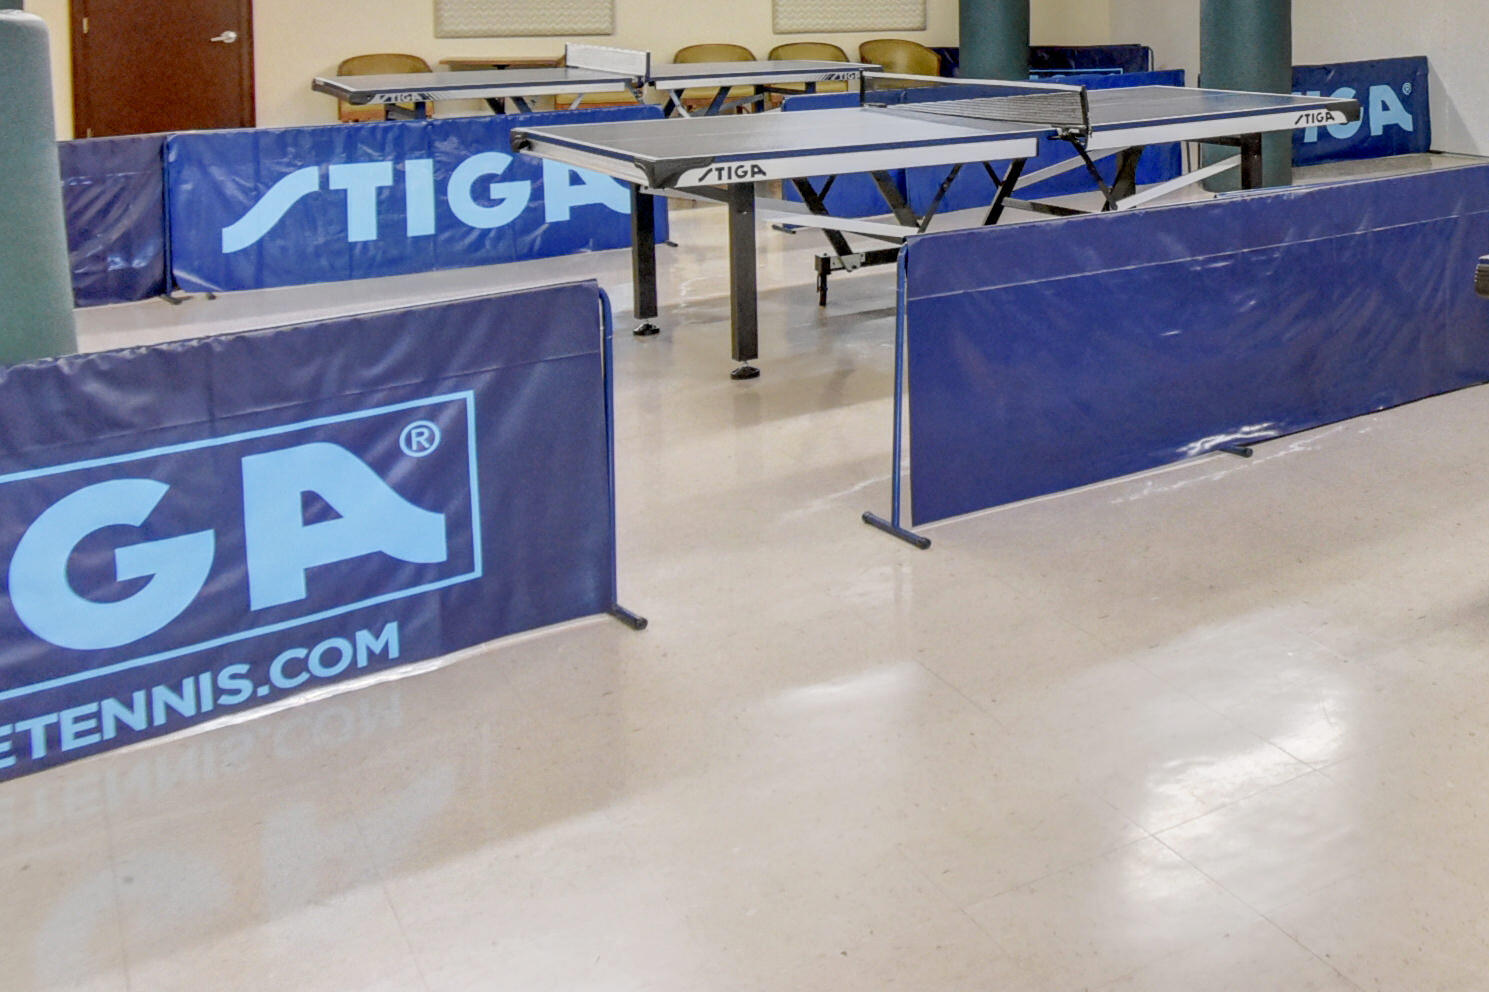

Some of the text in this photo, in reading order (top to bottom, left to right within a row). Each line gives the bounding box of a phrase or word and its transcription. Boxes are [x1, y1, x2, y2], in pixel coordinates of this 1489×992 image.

[1294, 111, 1335, 126] STIGA
[698, 163, 767, 183] STIGA
[221, 151, 631, 254] STIGA
